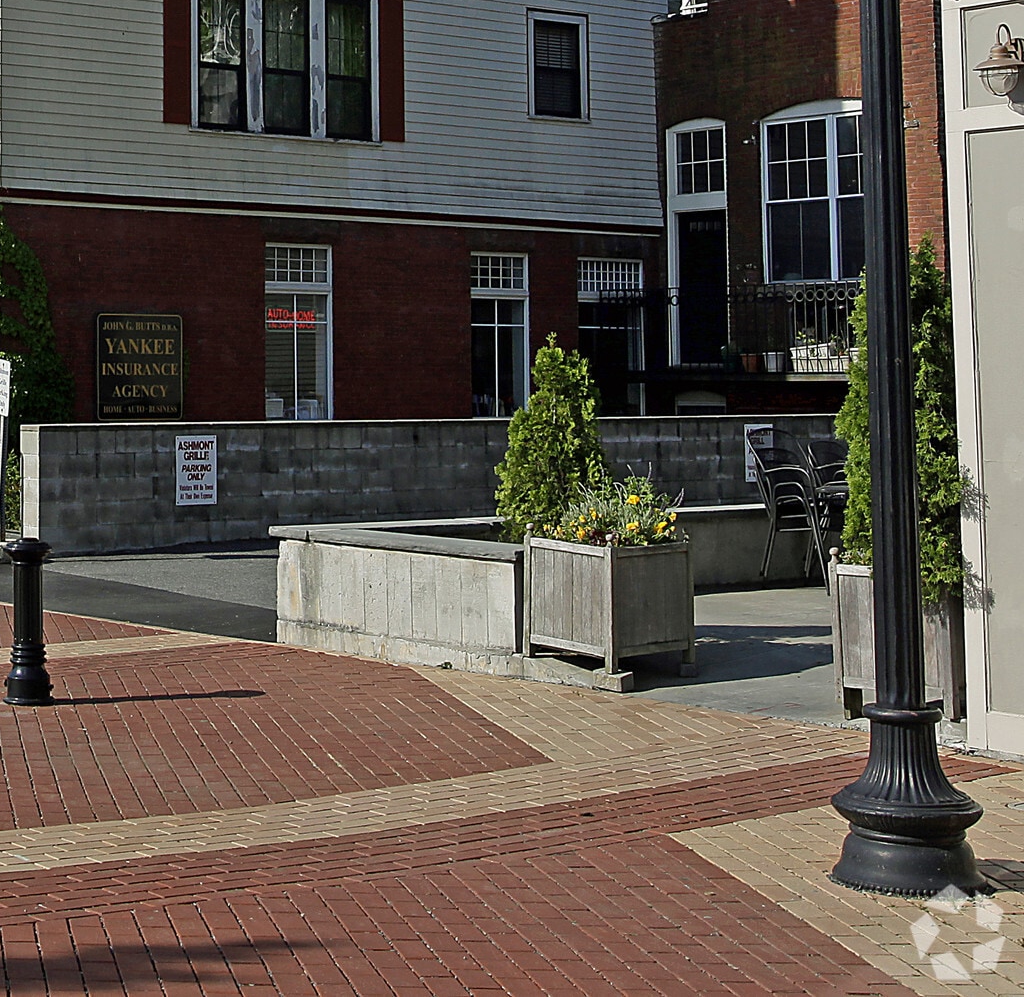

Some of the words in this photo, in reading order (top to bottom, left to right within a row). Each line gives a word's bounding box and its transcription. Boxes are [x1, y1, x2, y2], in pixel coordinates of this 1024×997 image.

[103, 322, 123, 330] JOHN
[135, 322, 161, 331] BUTTS
[105, 338, 175, 354] YANKEE
[102, 363, 178, 375] INSURANCE
[112, 385, 168, 398] AGENCY
[103, 405, 122, 413] HOME
[148, 405, 178, 413] BUSINESS
[178, 441, 214, 450] ASHMONT
[184, 451, 209, 460] GRILLE
[182, 464, 211, 472] PARKING
[187, 473, 205, 481] ONLY
